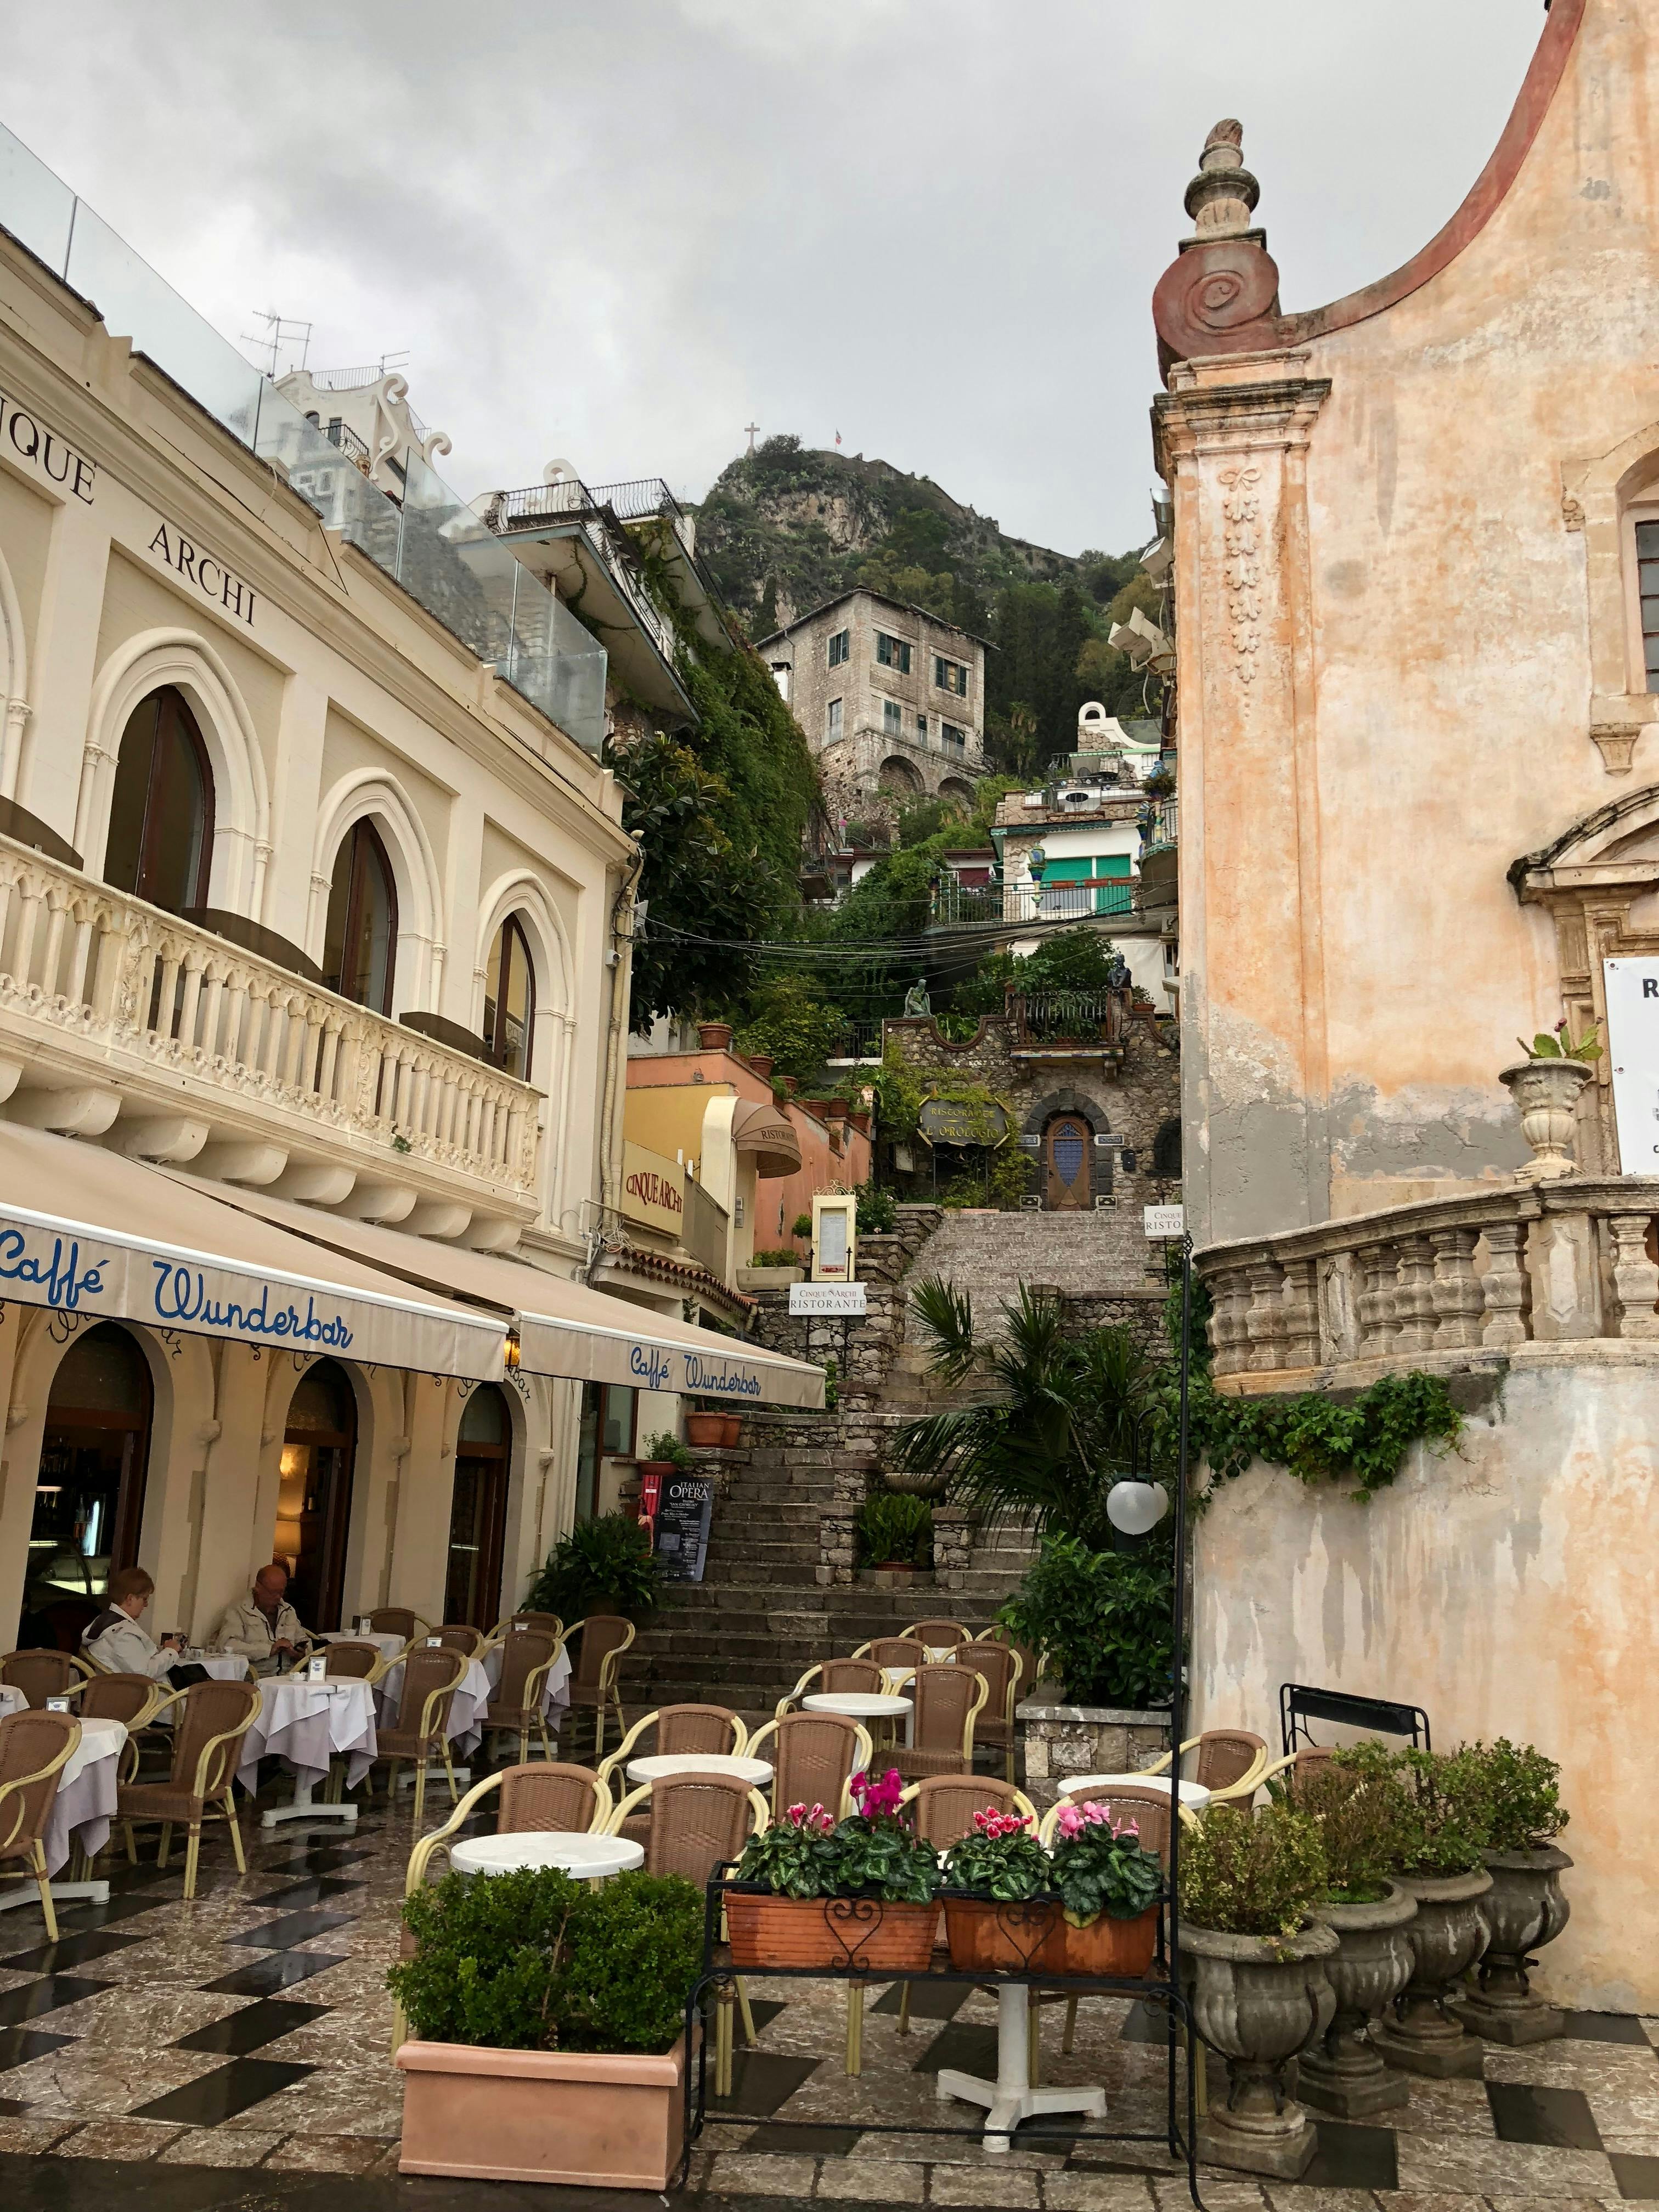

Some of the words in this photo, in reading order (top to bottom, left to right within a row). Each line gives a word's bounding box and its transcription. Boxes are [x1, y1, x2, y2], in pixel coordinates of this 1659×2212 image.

[0, 396, 95, 505] QUE
[148, 523, 257, 627] ARCHI
[930, 1108, 996, 1118] RISTORATE
[627, 1172, 658, 1205] CINQUE
[659, 1178, 682, 1212] ARCHI
[1146, 1221, 1182, 1229] RISTO
[0, 1229, 110, 1308] Caffé
[153, 1261, 353, 1348] Wunderbar
[790, 1300, 866, 1308] RISTORANTE
[631, 1347, 671, 1389] Caffé
[684, 1355, 761, 1396] Wunderbar
[670, 1485, 708, 1499] OPERA
